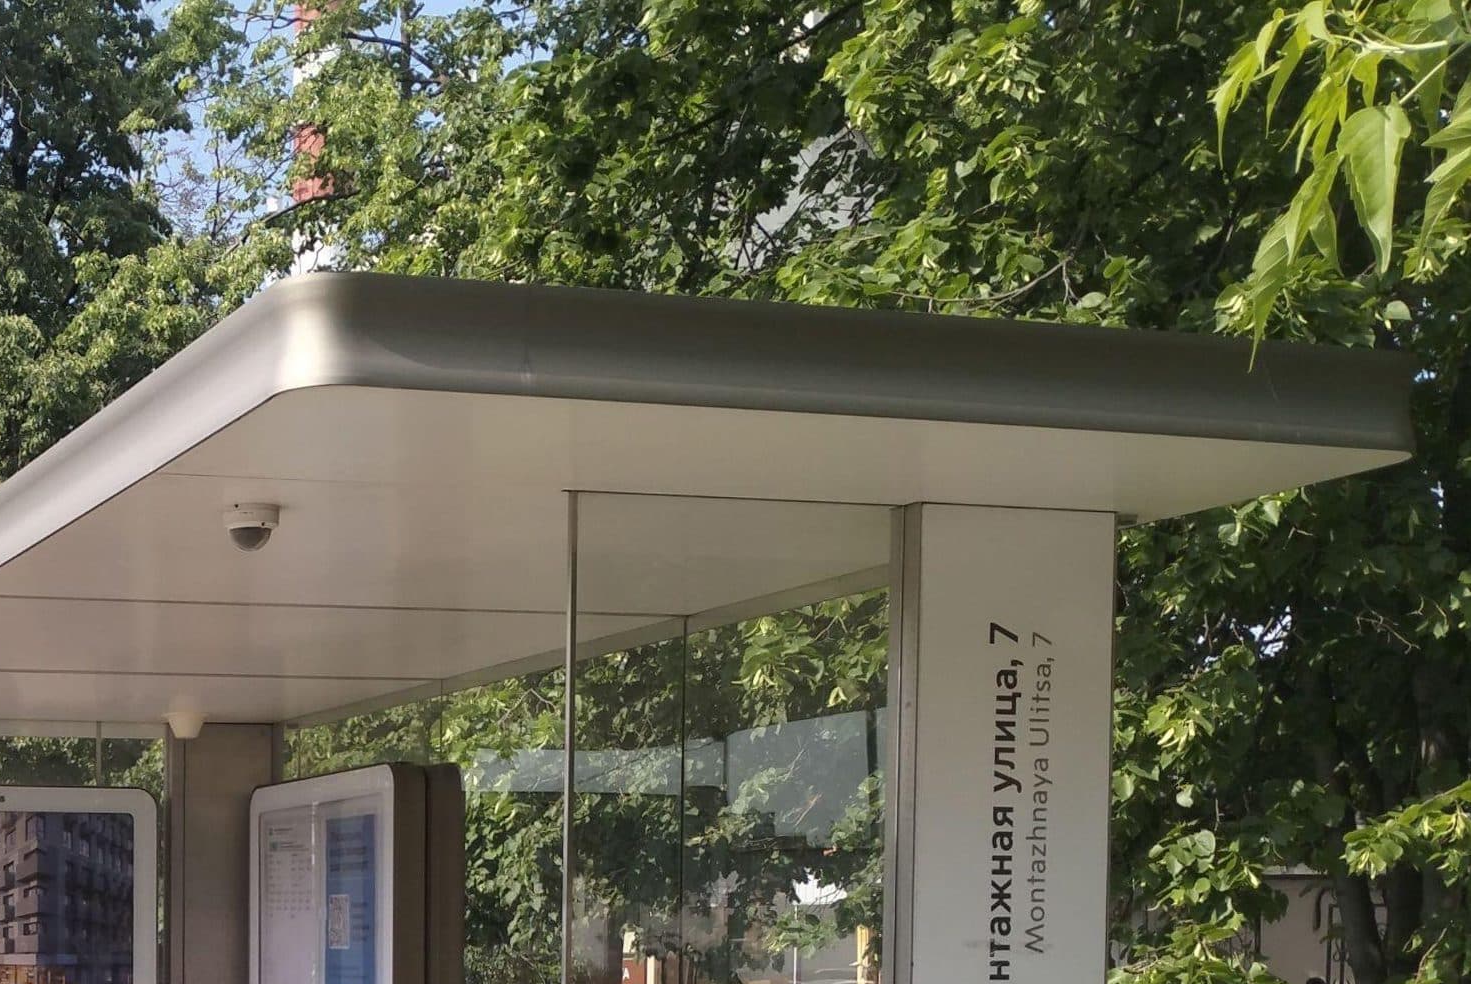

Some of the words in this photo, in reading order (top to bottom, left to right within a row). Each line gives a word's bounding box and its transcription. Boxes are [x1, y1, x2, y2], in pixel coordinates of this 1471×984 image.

[989, 621, 1020, 645] 7
[1031, 631, 1054, 648] 7
[992, 658, 1025, 794] улица,
[1028, 656, 1056, 747] Ulitsa,
[1024, 757, 1054, 954] Montazhnaya
